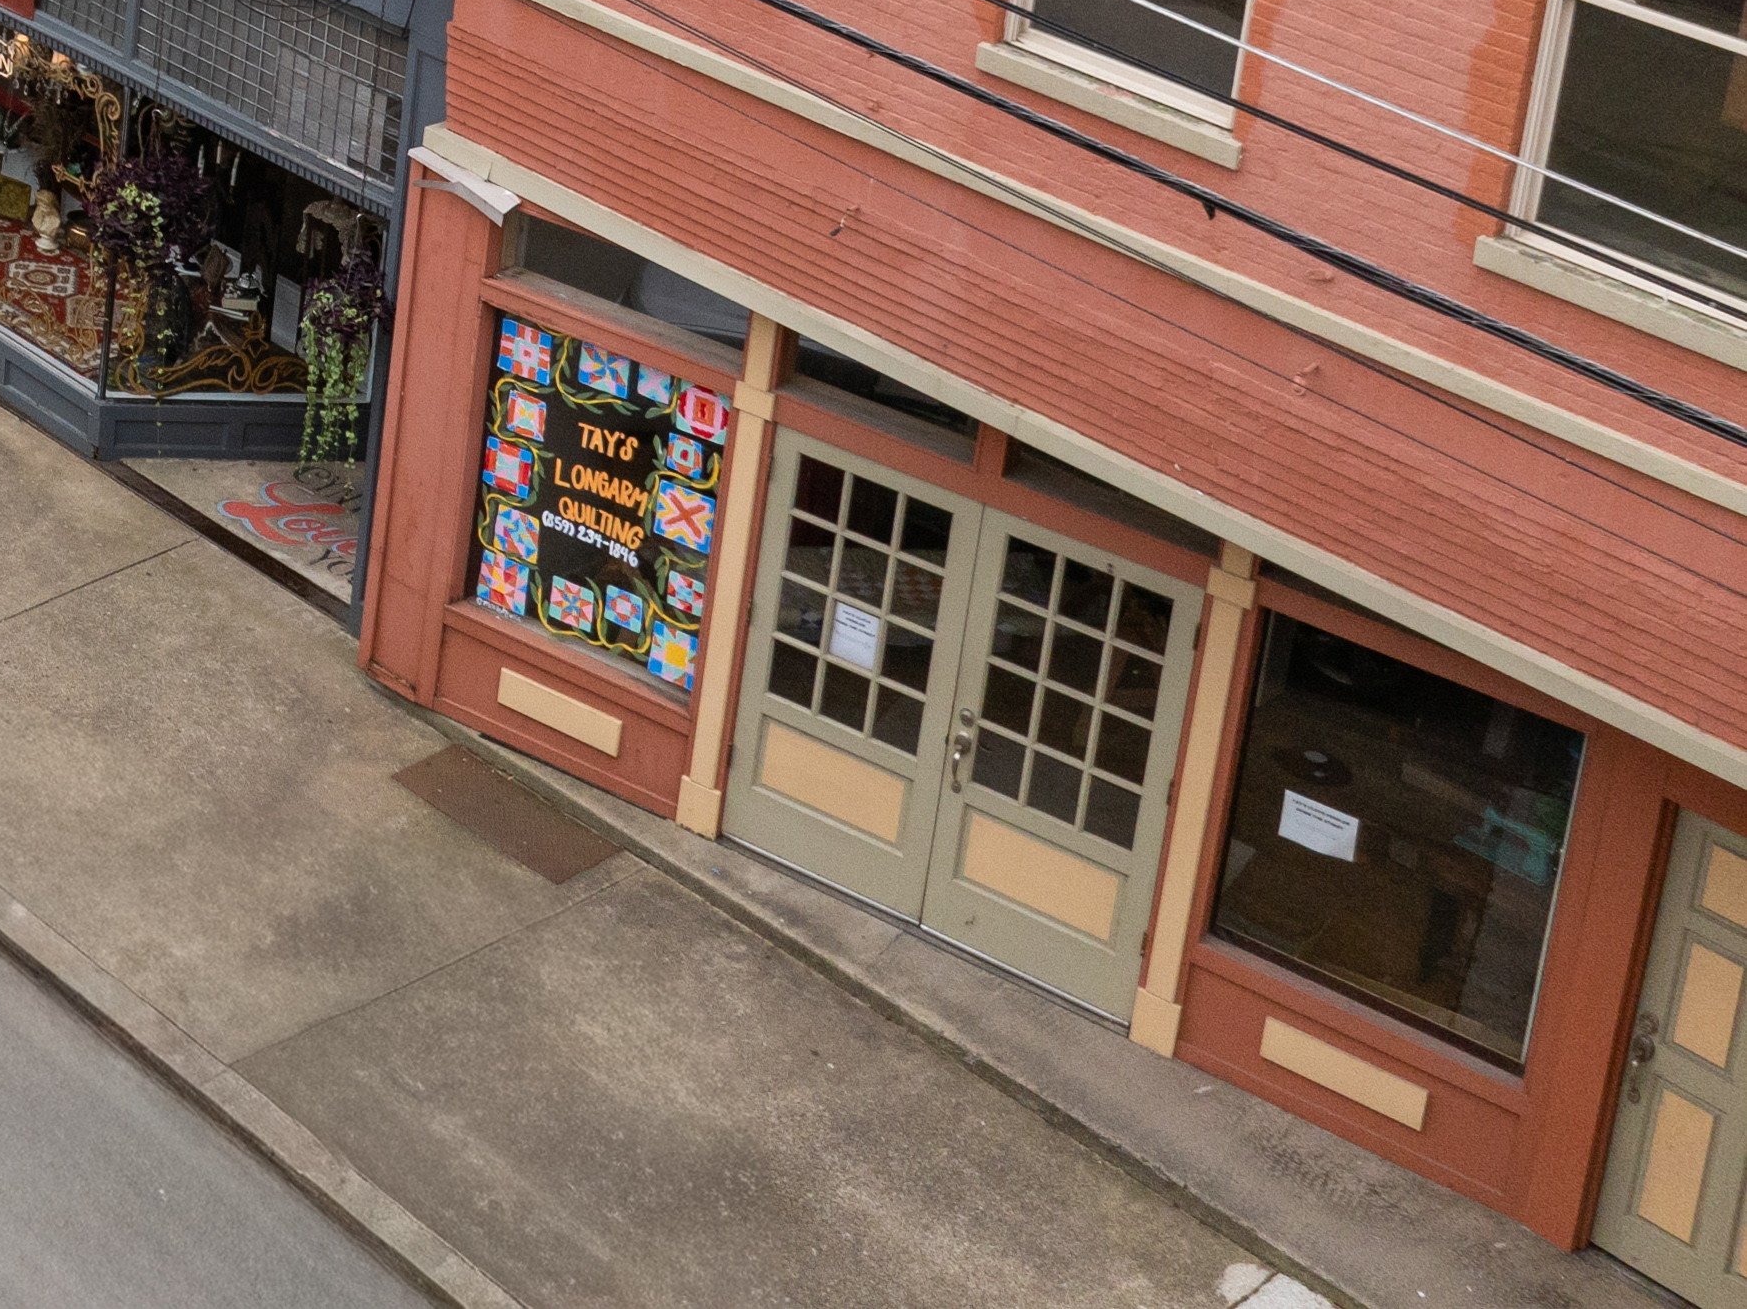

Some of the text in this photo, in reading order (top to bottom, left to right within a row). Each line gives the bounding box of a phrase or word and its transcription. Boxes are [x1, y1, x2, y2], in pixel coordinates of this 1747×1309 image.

[578, 422, 639, 462] TAY'S
[555, 457, 649, 518] LONGARM
[542, 510, 640, 568] (859) 234-1846
[558, 496, 645, 550] QUILTING
